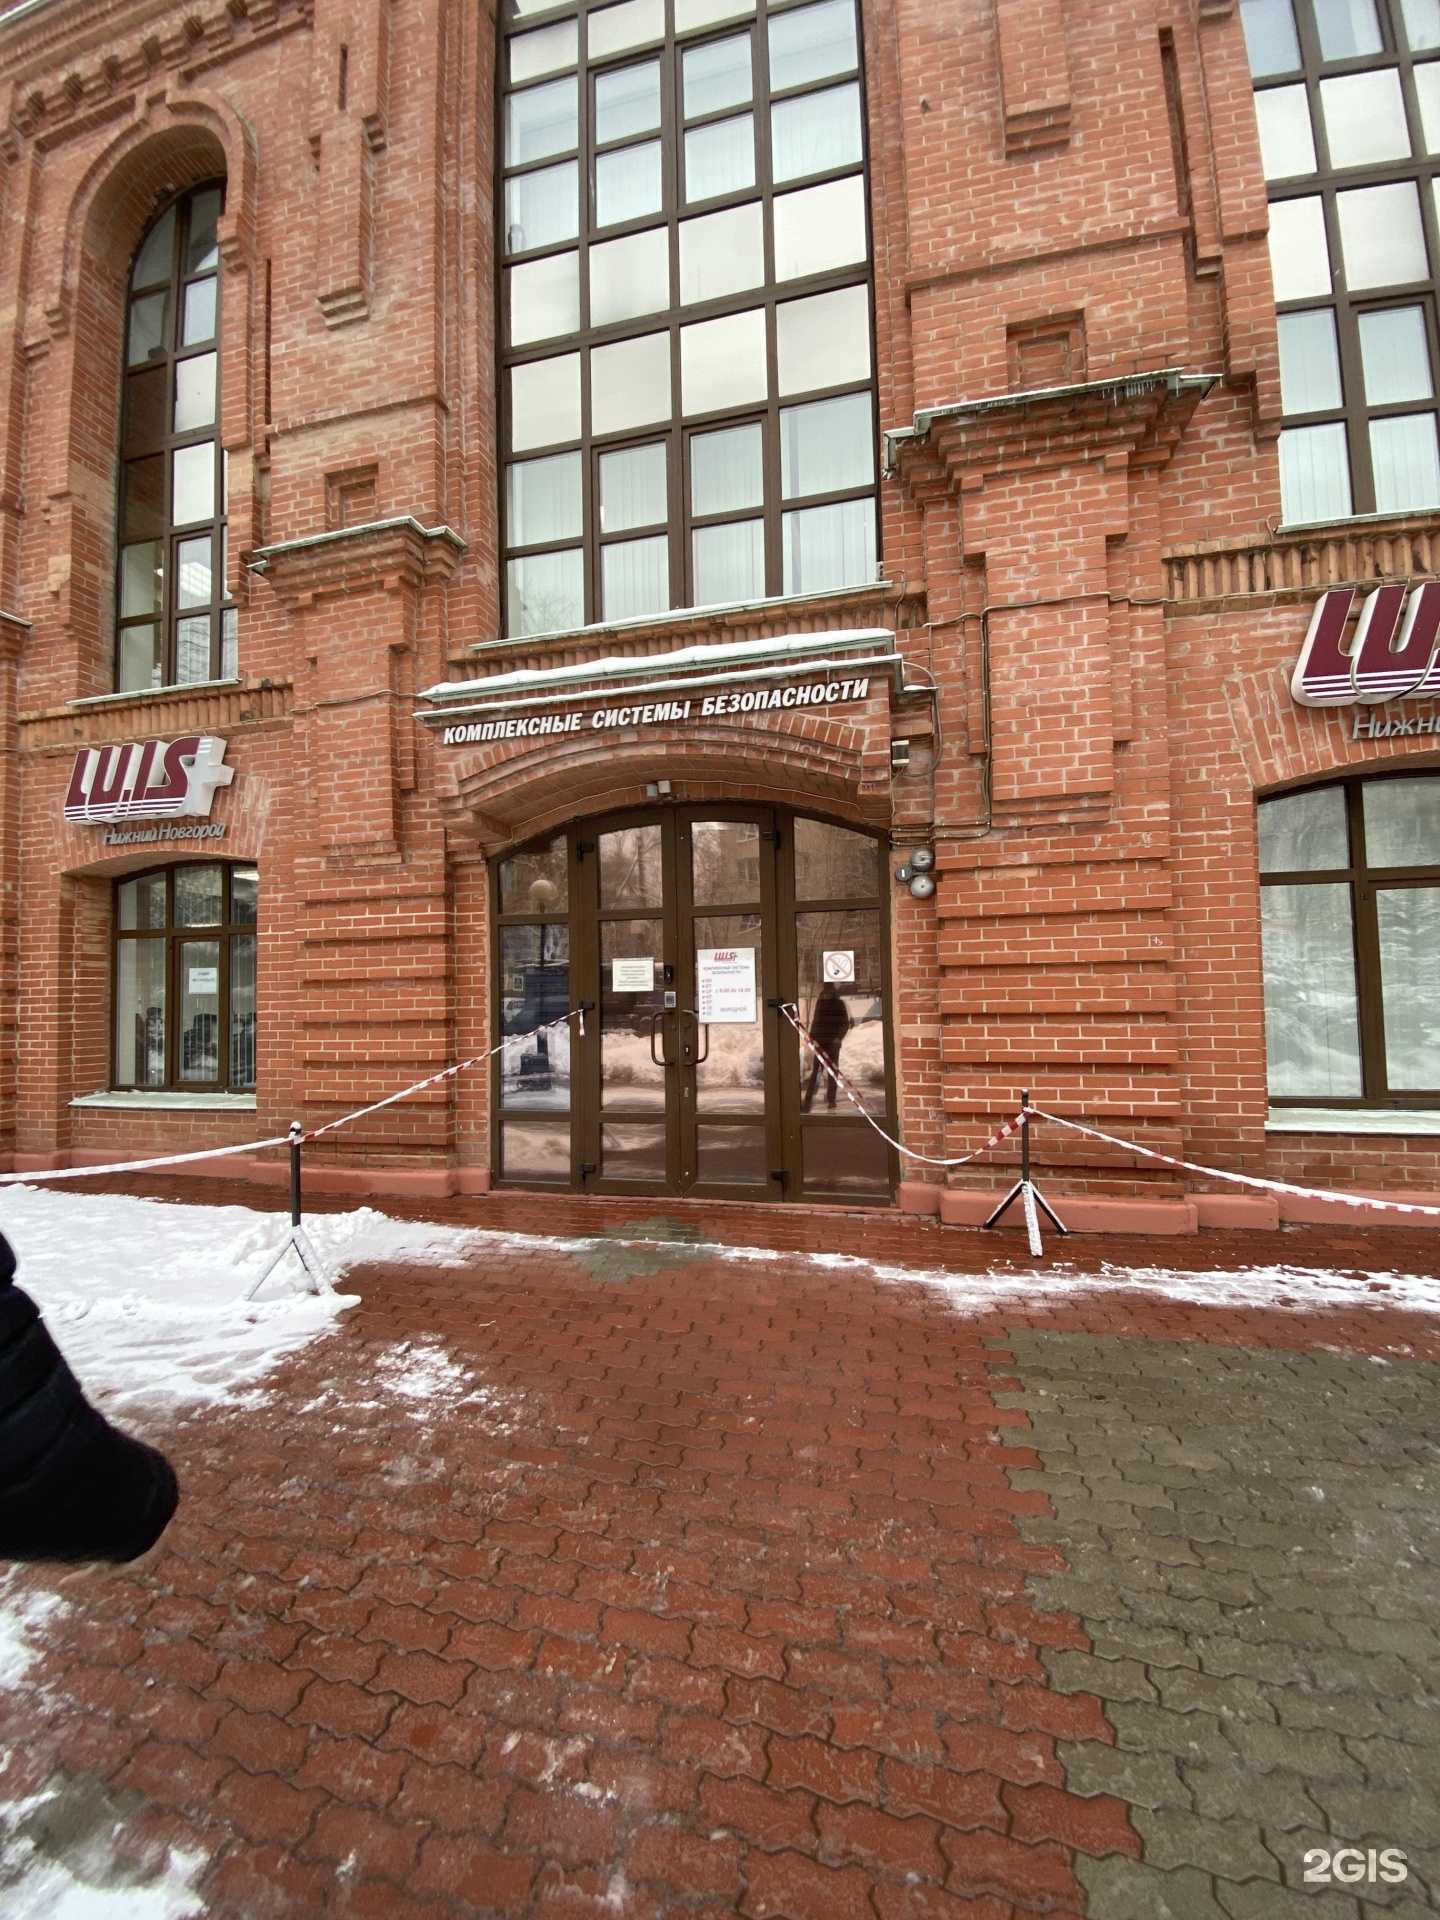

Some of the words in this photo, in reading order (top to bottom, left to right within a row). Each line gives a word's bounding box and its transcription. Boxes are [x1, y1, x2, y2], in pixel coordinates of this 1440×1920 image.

[443, 712, 582, 745] КОМПЛЕКСНЫЕ
[591, 700, 691, 729] СИСТЕМЫ
[701, 678, 869, 717] БЕЗОПАСНОСТИ
[103, 826, 159, 846] Нижний
[159, 822, 226, 841] Новгород
